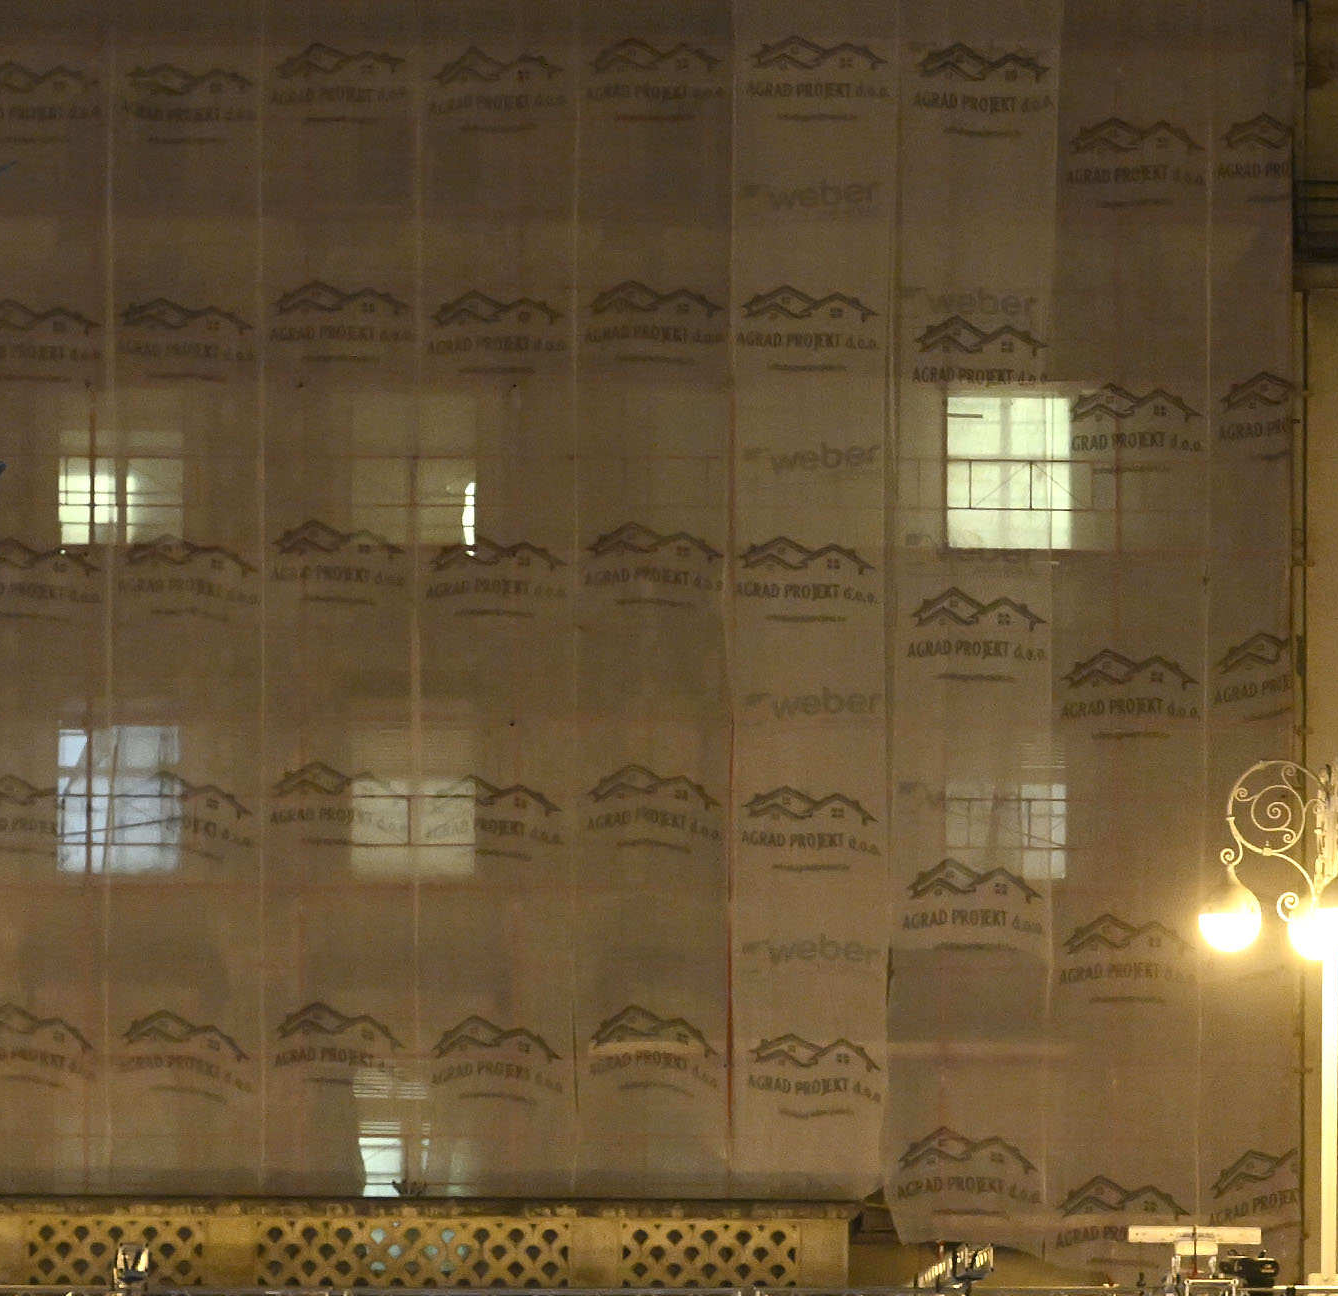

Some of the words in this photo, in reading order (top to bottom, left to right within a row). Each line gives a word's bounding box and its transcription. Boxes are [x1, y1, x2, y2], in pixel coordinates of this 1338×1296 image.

[770, 443, 881, 475] weber
[907, 640, 952, 660] AGRAD
[956, 641, 1009, 660] PROJEKT
[773, 689, 882, 718] weber
[902, 910, 944, 928] AGRAD
[950, 909, 1008, 927] PROJEKT
[768, 935, 881, 963] weber
[897, 1178, 944, 1200] AGRAD
[948, 1175, 1004, 1196] PROJEKT
